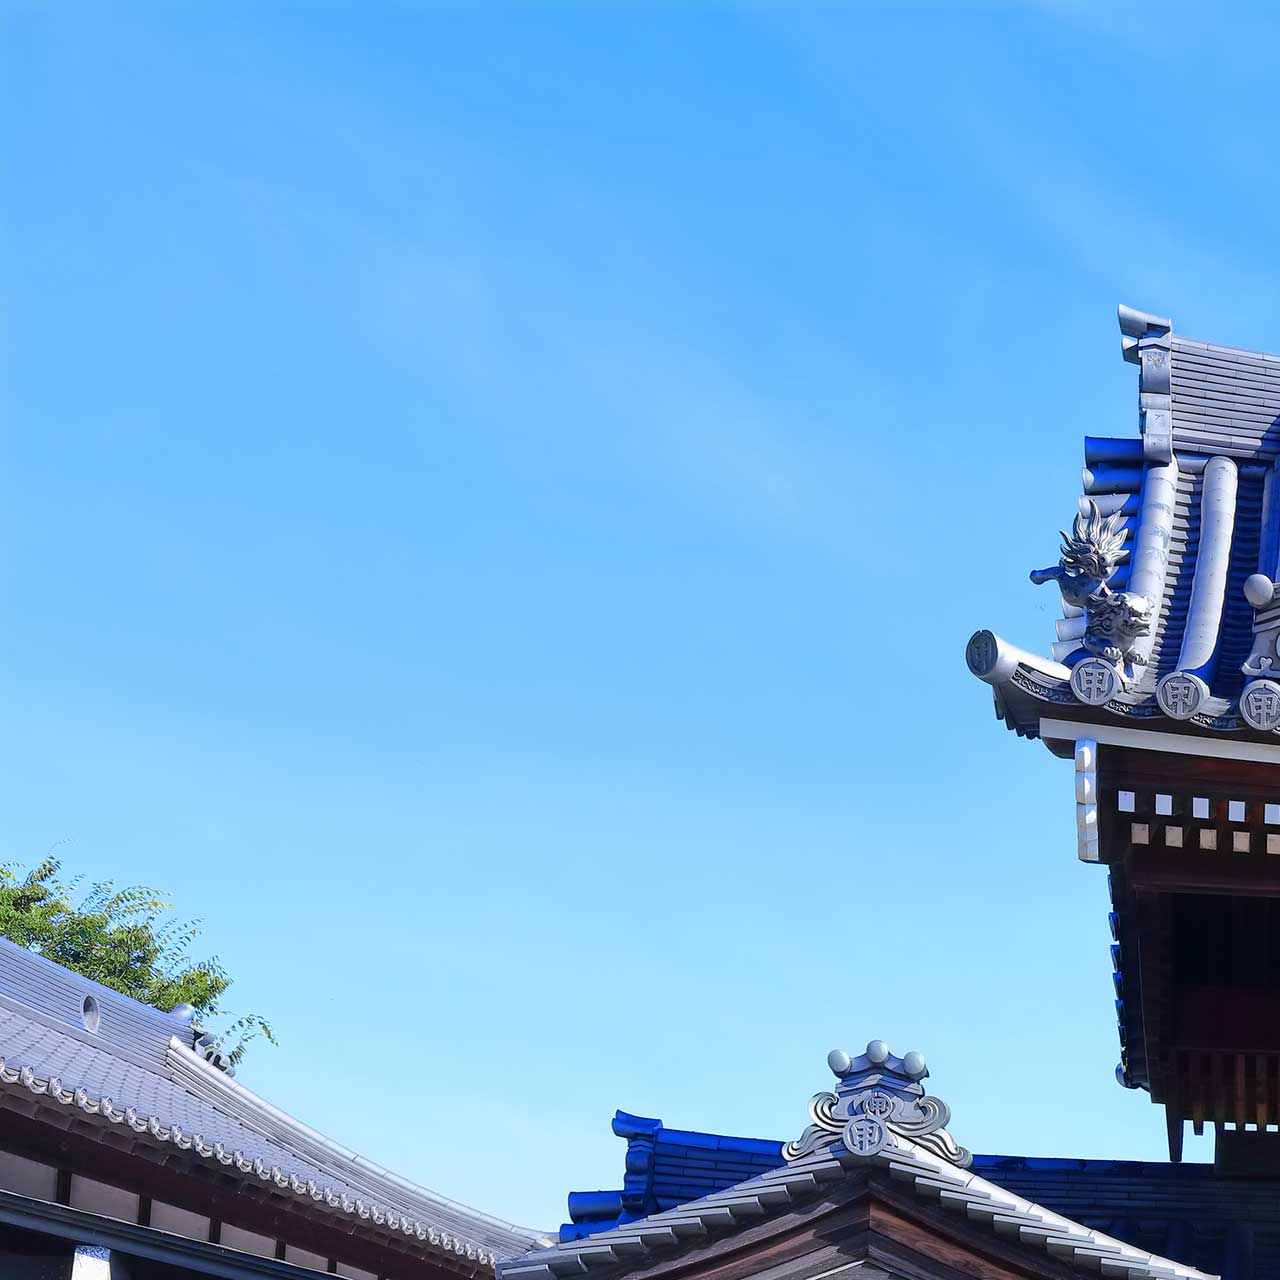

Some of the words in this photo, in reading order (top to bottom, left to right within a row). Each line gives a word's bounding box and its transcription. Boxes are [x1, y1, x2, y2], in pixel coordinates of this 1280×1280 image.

[1081, 667, 1111, 701] 甲
[1166, 681, 1197, 715] 甲
[1249, 692, 1275, 726] 甲
[853, 1122, 880, 1151] 甲
